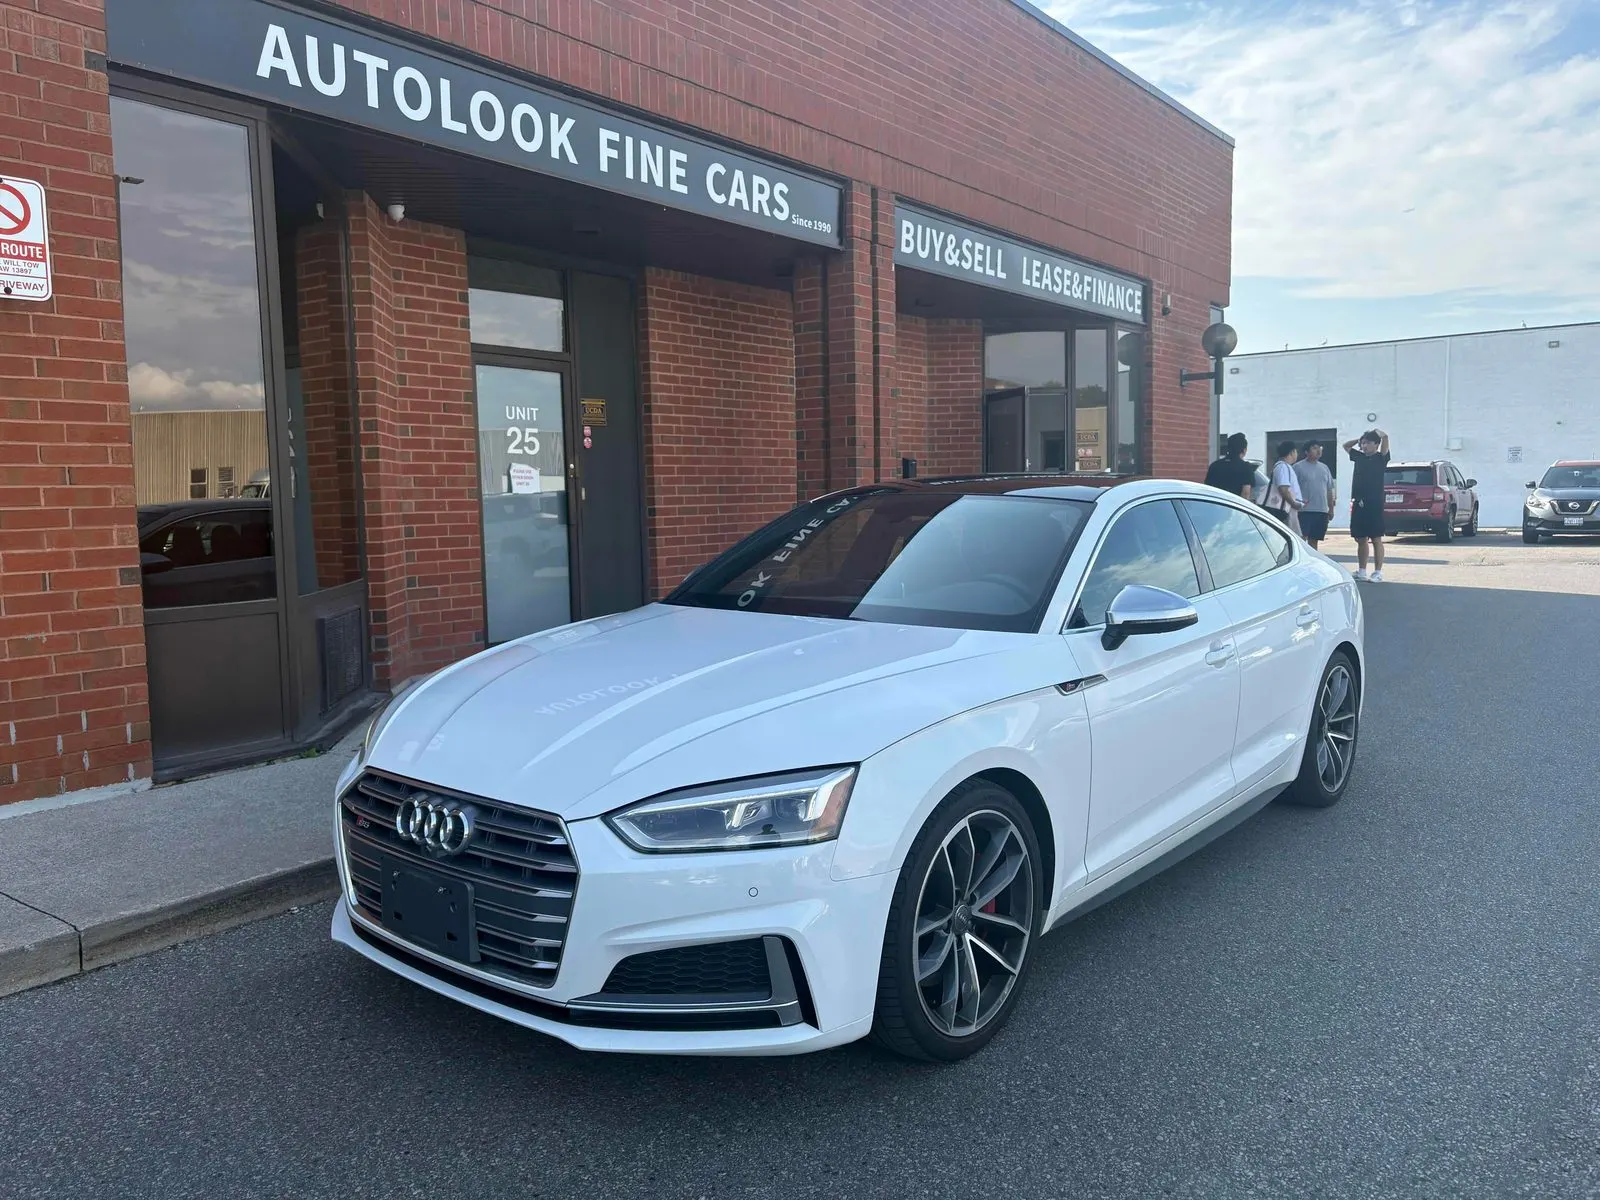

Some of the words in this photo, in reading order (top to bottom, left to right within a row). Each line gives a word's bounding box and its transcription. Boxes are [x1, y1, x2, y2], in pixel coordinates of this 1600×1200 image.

[256, 23, 578, 165] AUTOLOOK
[599, 128, 688, 194] FINE
[706, 162, 790, 221] CARS
[791, 213, 812, 228] Since
[814, 220, 832, 234] 1990
[1, 243, 43, 258] ROUTE
[3, 259, 21, 267] WILL
[12, 267, 32, 275] 13897
[901, 219, 1007, 279] BUY&SELL
[1022, 256, 1142, 315] LEASE&FINANCE
[505, 405, 539, 421] UNIT
[506, 426, 540, 455] 25
